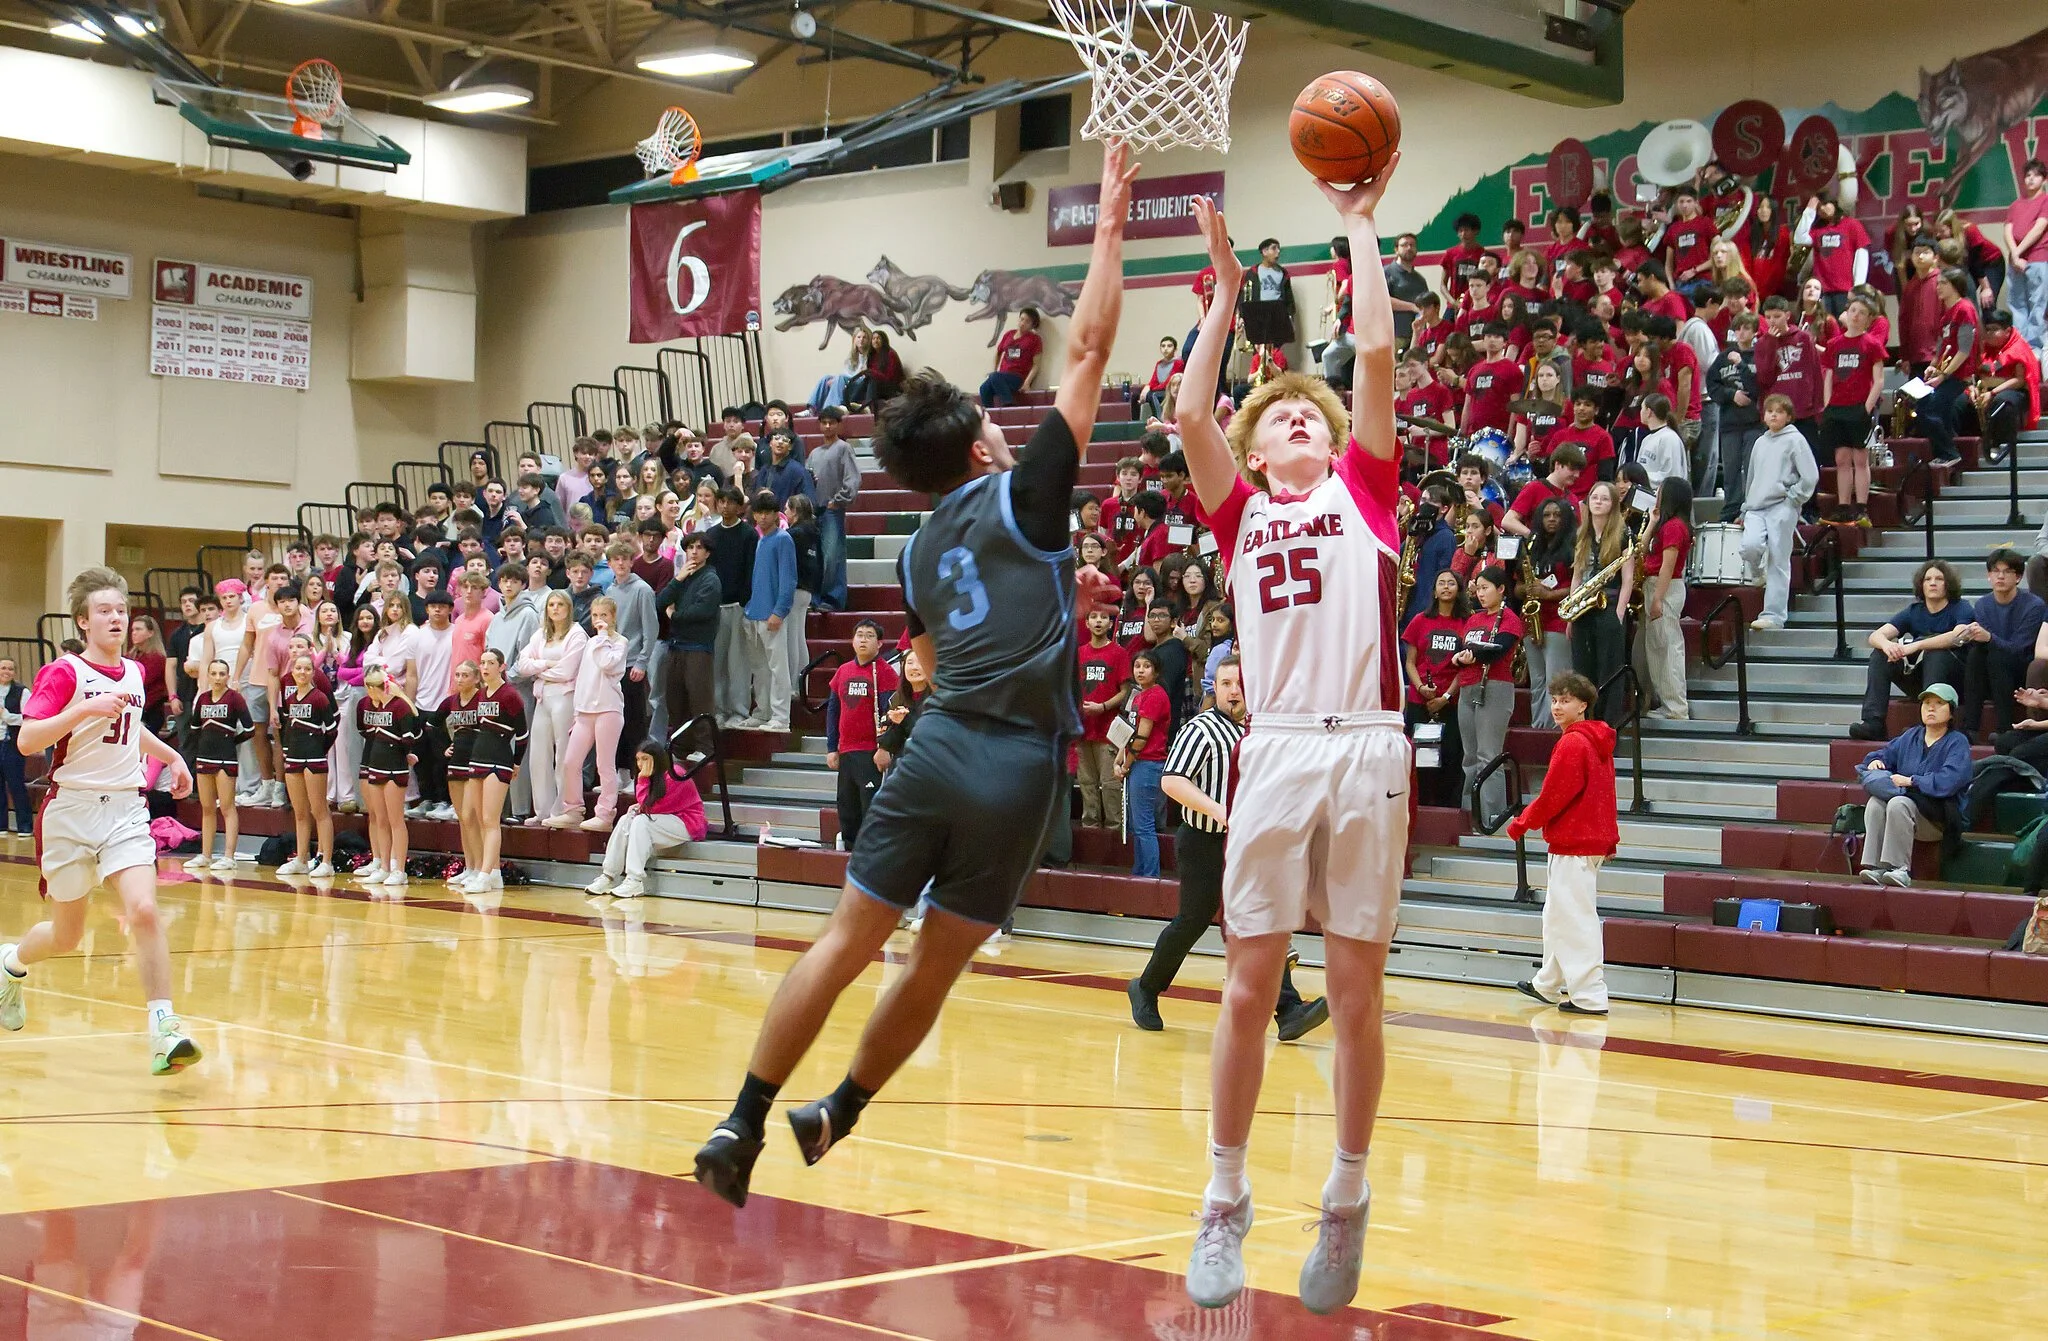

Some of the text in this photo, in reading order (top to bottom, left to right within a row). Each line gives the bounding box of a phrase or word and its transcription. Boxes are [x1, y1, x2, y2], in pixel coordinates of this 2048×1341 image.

[1071, 196, 1195, 227] EASTE STUDENTS
[15, 246, 125, 276] WRESTLING
[667, 220, 711, 315] 6
[27, 269, 111, 289] CHAMPIONS
[207, 272, 303, 298] ACADEMIC
[215, 292, 294, 311] CHAMPIONS
[221, 325, 246, 336] 2007
[156, 340, 181, 352] 2011
[188, 344, 214, 355] 2012
[220, 348, 246, 358] 2012
[251, 374, 276, 384] 2022
[282, 377, 306, 388] 2023
[1116, 521, 1134, 530] BND
[938, 546, 991, 632] 3
[1256, 547, 1322, 615] 25
[1432, 634, 1457, 643] EHS PEP
[102, 712, 131, 746] 31
